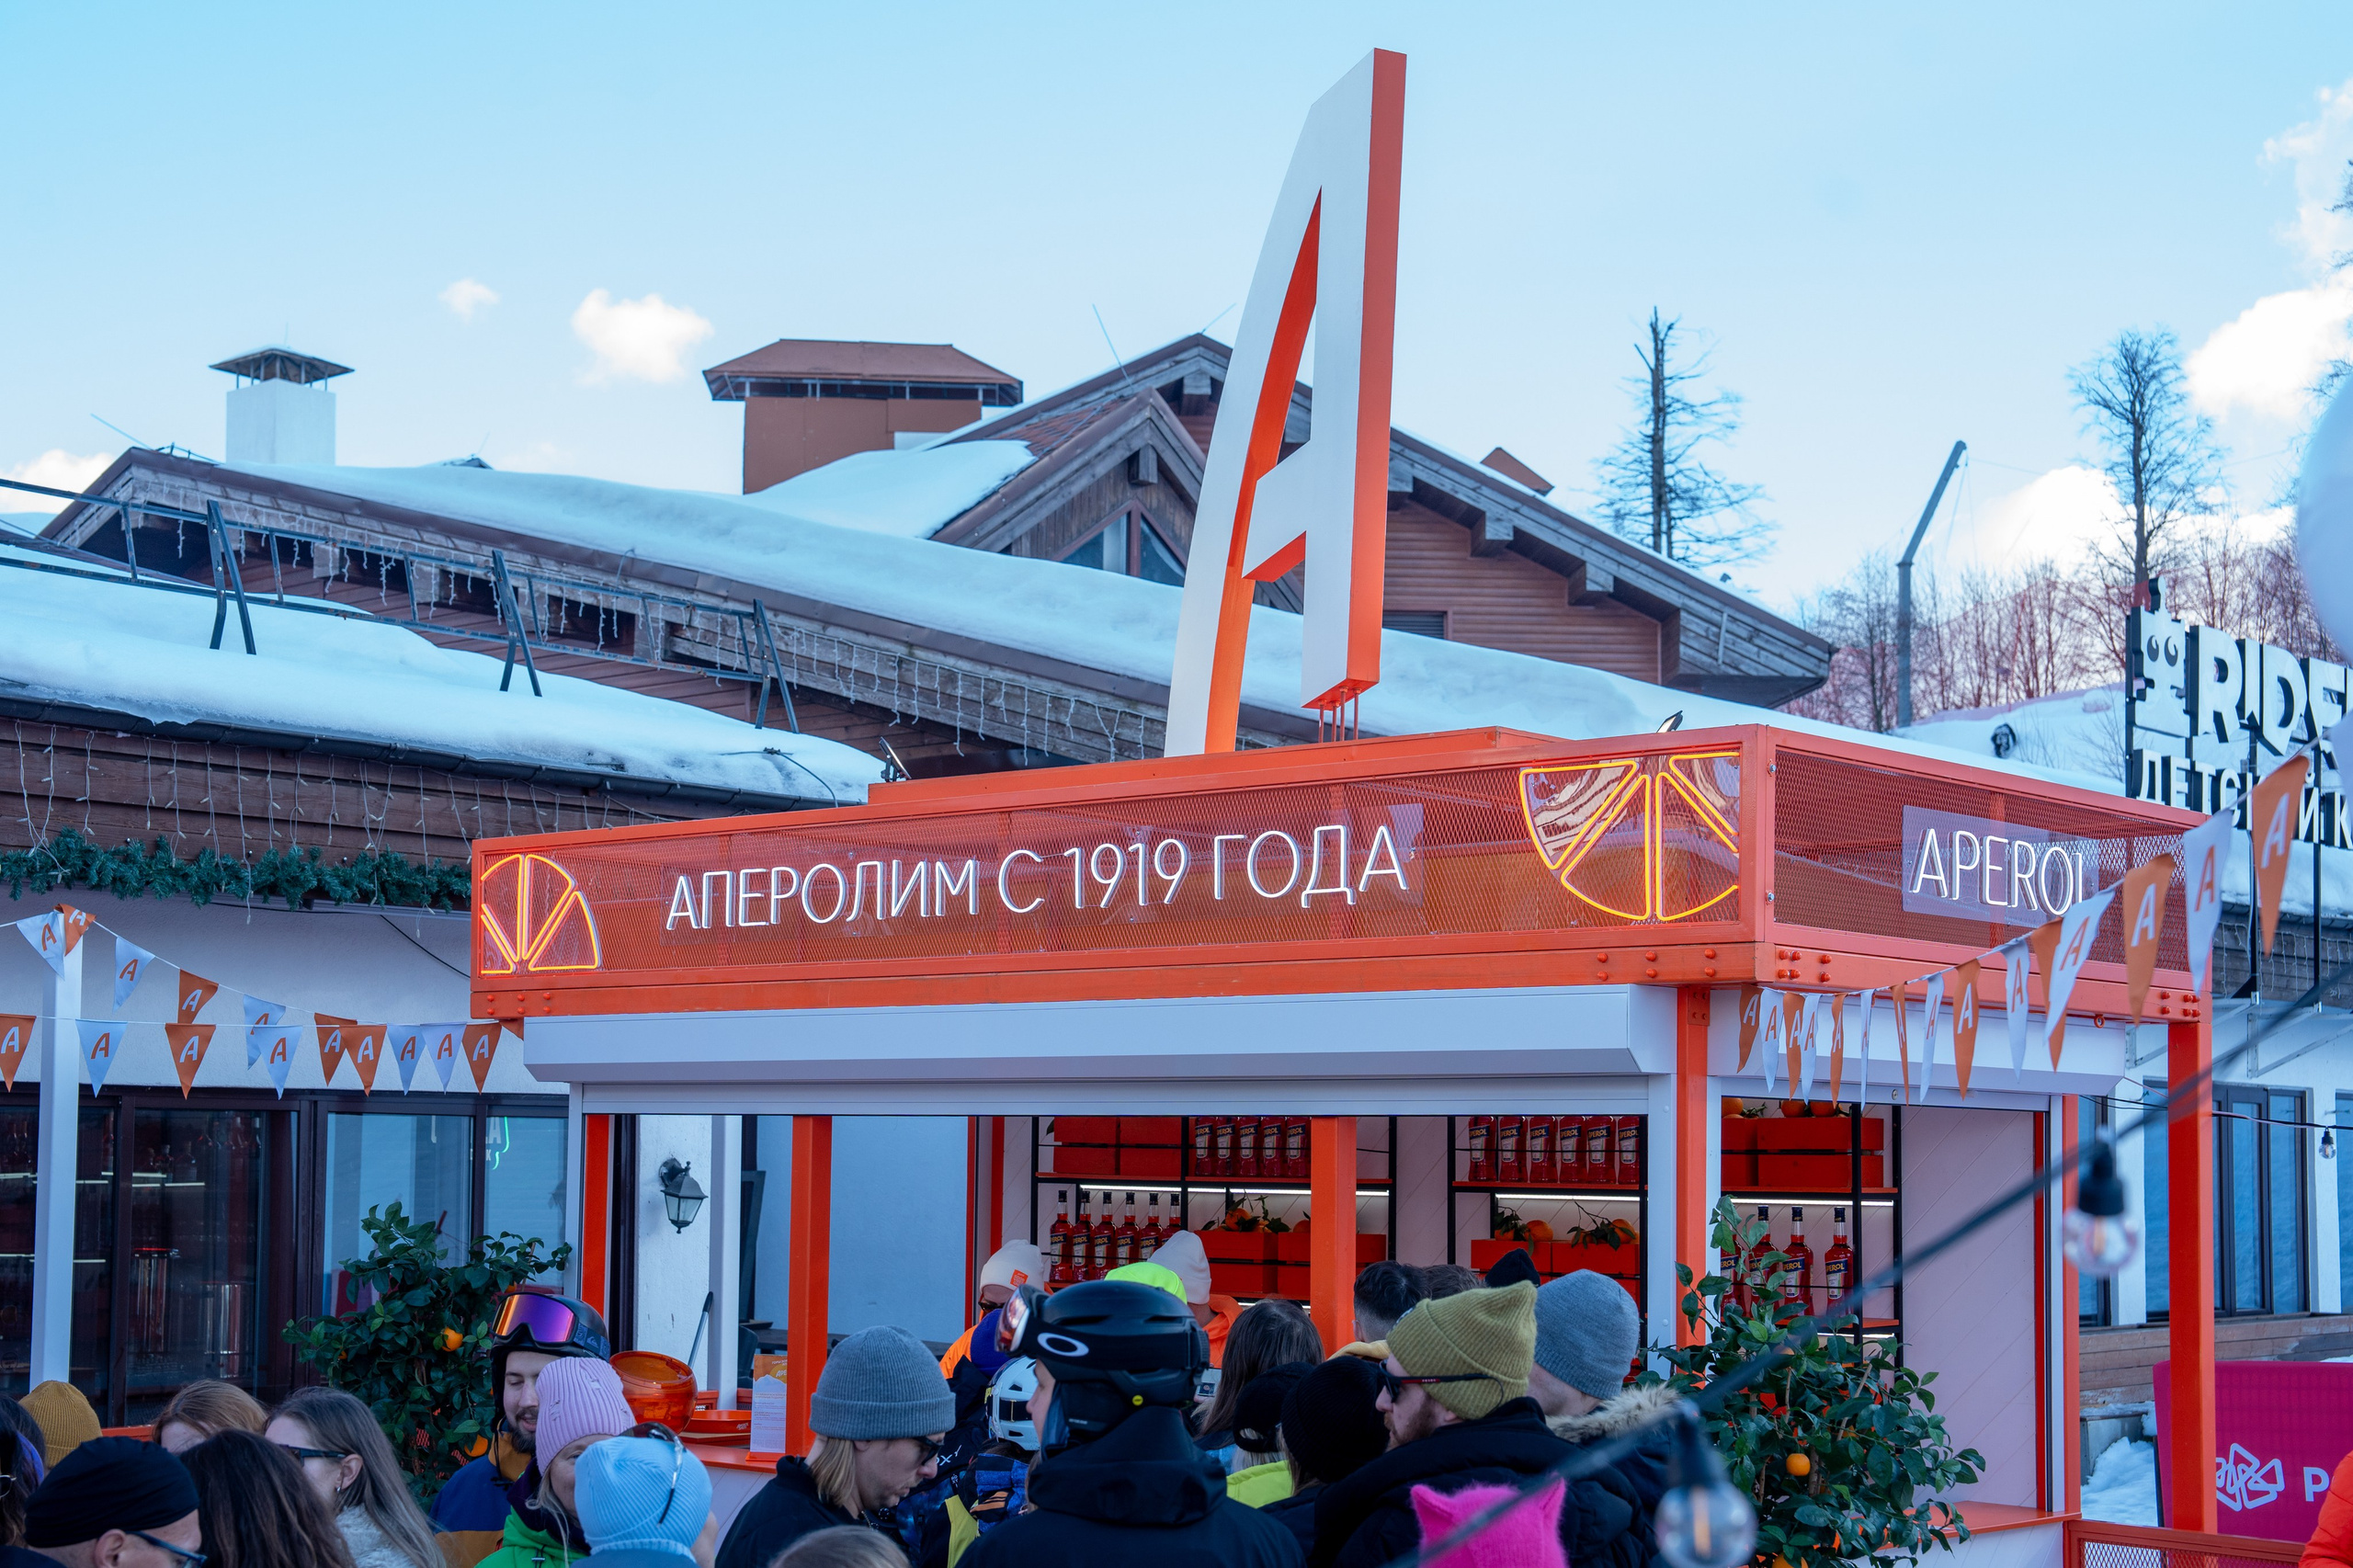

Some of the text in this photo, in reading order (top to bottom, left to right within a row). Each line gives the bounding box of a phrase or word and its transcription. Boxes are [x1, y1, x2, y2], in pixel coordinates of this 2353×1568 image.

[1166, 48, 1407, 757] A
[2193, 624, 2353, 757] RIDE
[2261, 792, 2290, 869] A
[665, 824, 1410, 930] АПЕРОЛИМ С 1919 ГОДА
[2194, 845, 2214, 912] A
[69, 908, 86, 926] A
[2131, 882, 2156, 948] A
[41, 923, 57, 951] A
[2059, 916, 2090, 971] A
[119, 959, 138, 982] A
[2011, 958, 2023, 1013] A
[182, 989, 202, 1012] A
[1743, 994, 1759, 1027] A
[1927, 994, 1938, 1040] A
[1957, 983, 1973, 1035] A
[1765, 1005, 1777, 1042] A
[1789, 1009, 1801, 1049] A
[1803, 1011, 1815, 1051] A
[0, 1027, 19, 1054] A
[90, 1032, 110, 1060] A
[179, 1036, 199, 1063] A
[270, 1037, 287, 1063] A
[324, 1028, 342, 1053] A
[357, 1035, 374, 1063] A
[400, 1036, 416, 1061] A
[437, 1033, 452, 1061] A
[472, 1034, 489, 1061] A
